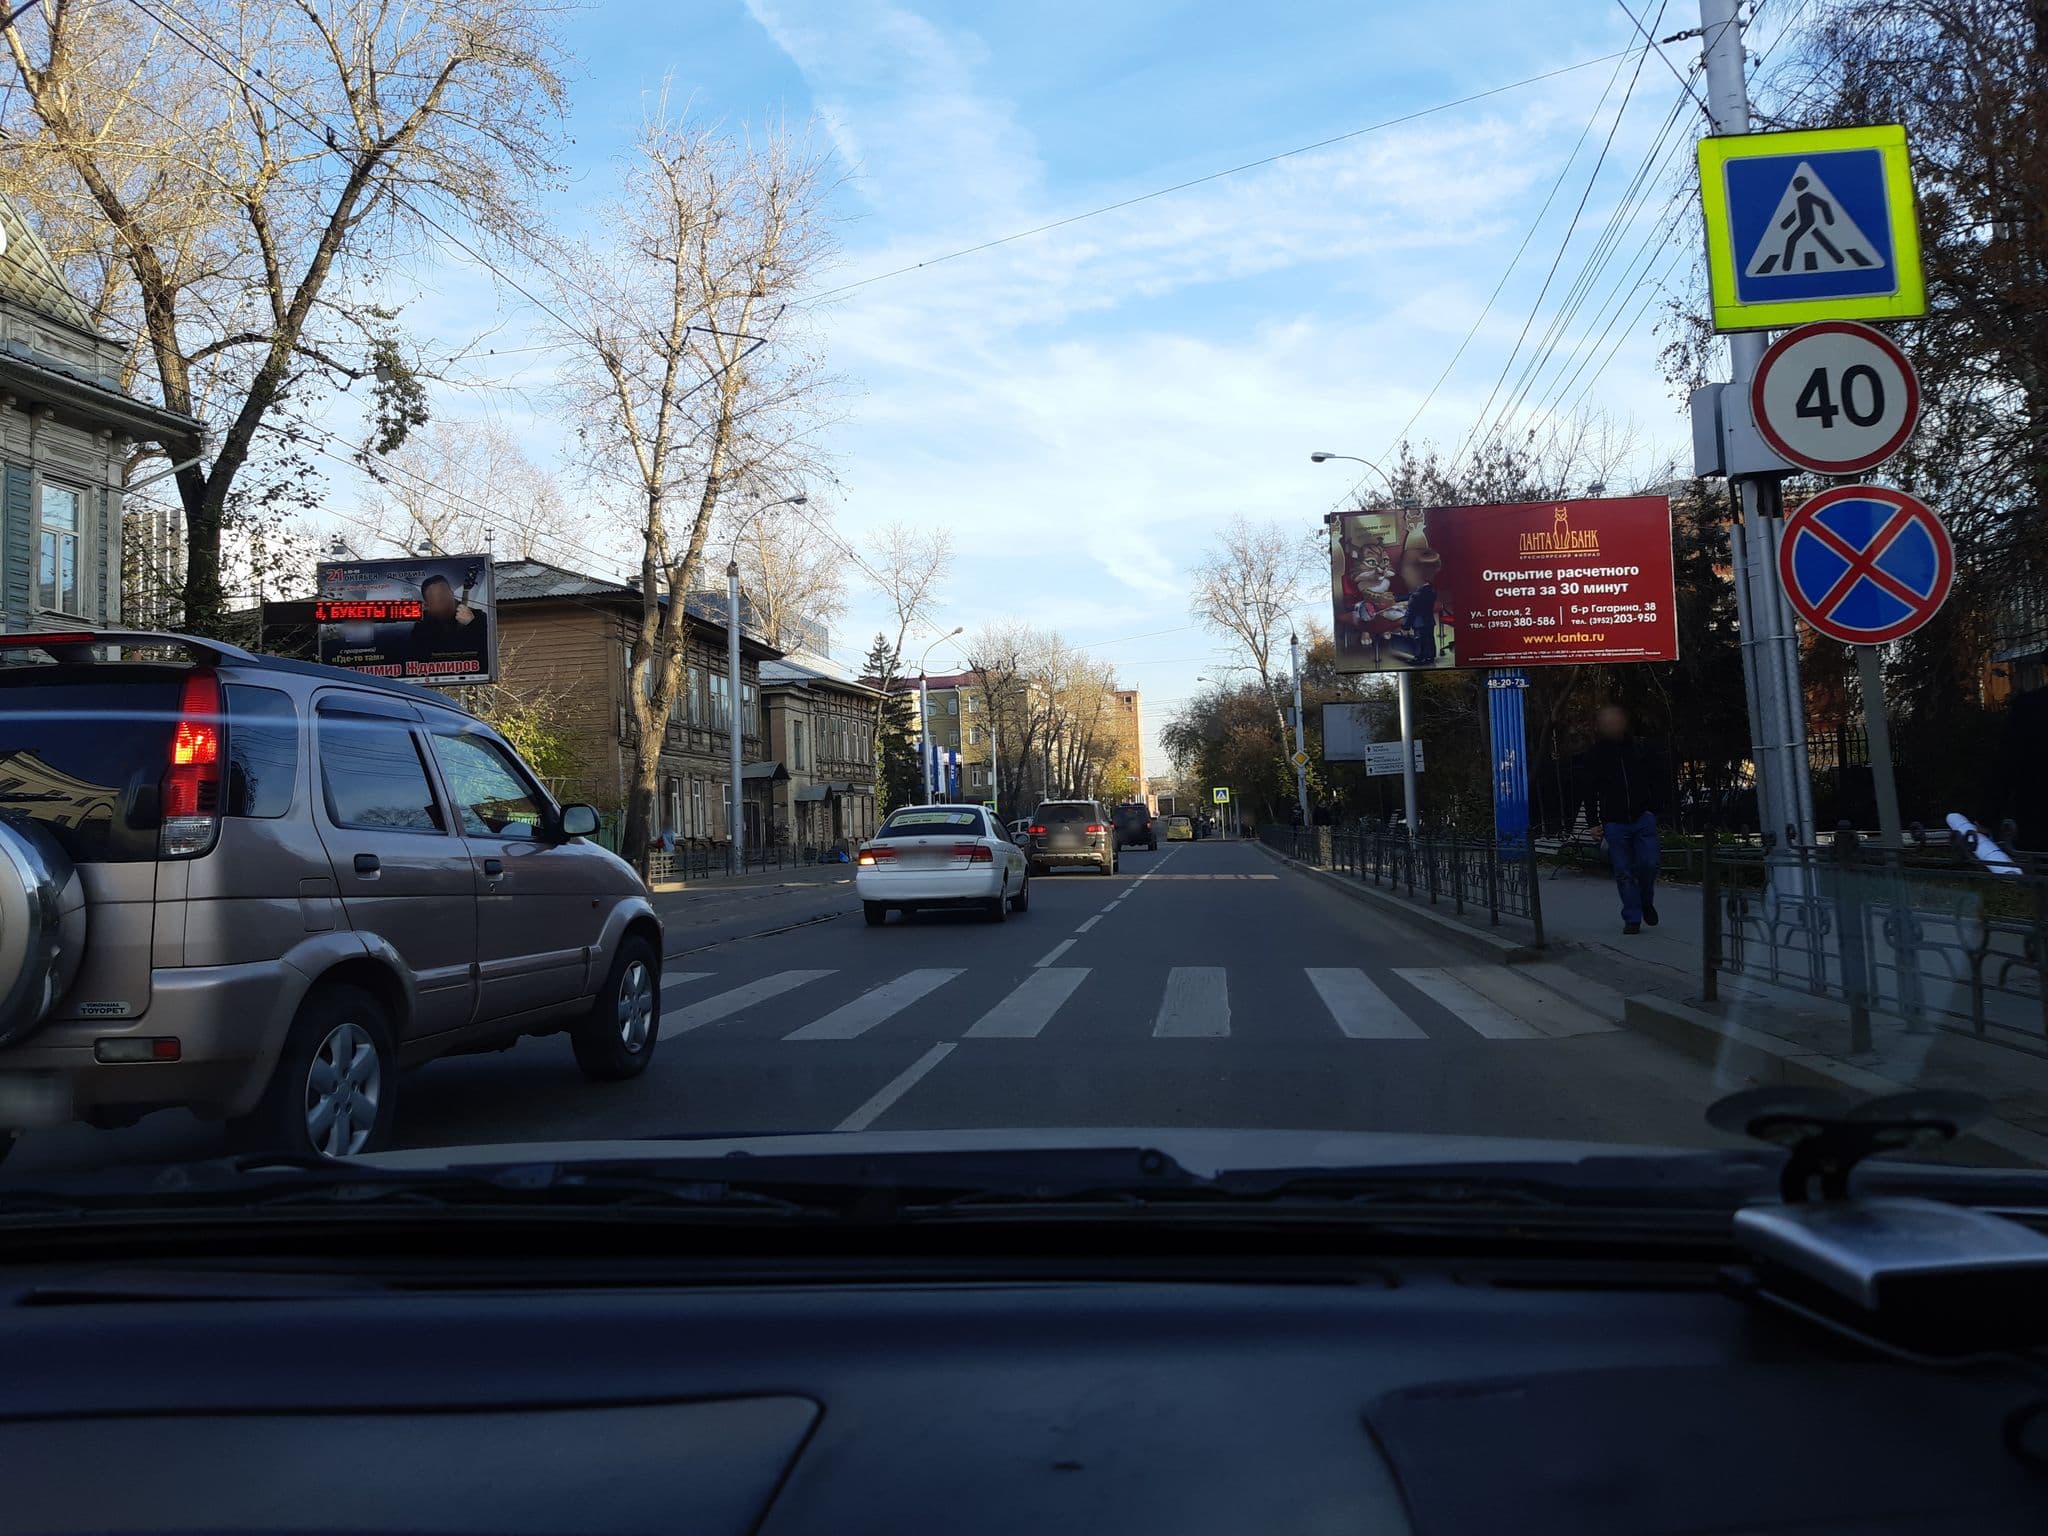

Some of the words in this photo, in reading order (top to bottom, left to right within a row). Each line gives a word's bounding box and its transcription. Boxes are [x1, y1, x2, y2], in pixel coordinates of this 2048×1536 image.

[1796, 363, 1885, 428] 40
[1571, 530, 1599, 548] БАНК
[327, 568, 343, 583] 21
[1482, 569, 1553, 583] Открытие
[1557, 566, 1639, 581] расчетного
[1495, 586, 1536, 597] счета
[1539, 585, 1556, 596] за
[1560, 583, 1579, 594] 30
[1583, 583, 1629, 595] минут
[331, 606, 386, 618] БУКЕТЫ
[1470, 610, 1485, 619] ул.
[1487, 608, 1523, 617] Гоголя,
[1524, 607, 1531, 615] 2
[1570, 604, 1589, 615] б-р
[1591, 604, 1642, 613] Гагарина,
[1643, 602, 1656, 611] 38
[1513, 616, 1556, 627] 380-586
[1613, 613, 1657, 624] 203-950
[1523, 632, 1605, 645] www.lanta.ru
[405, 660, 480, 675] Ждамиров
[1488, 678, 1525, 687] 48-20-73
